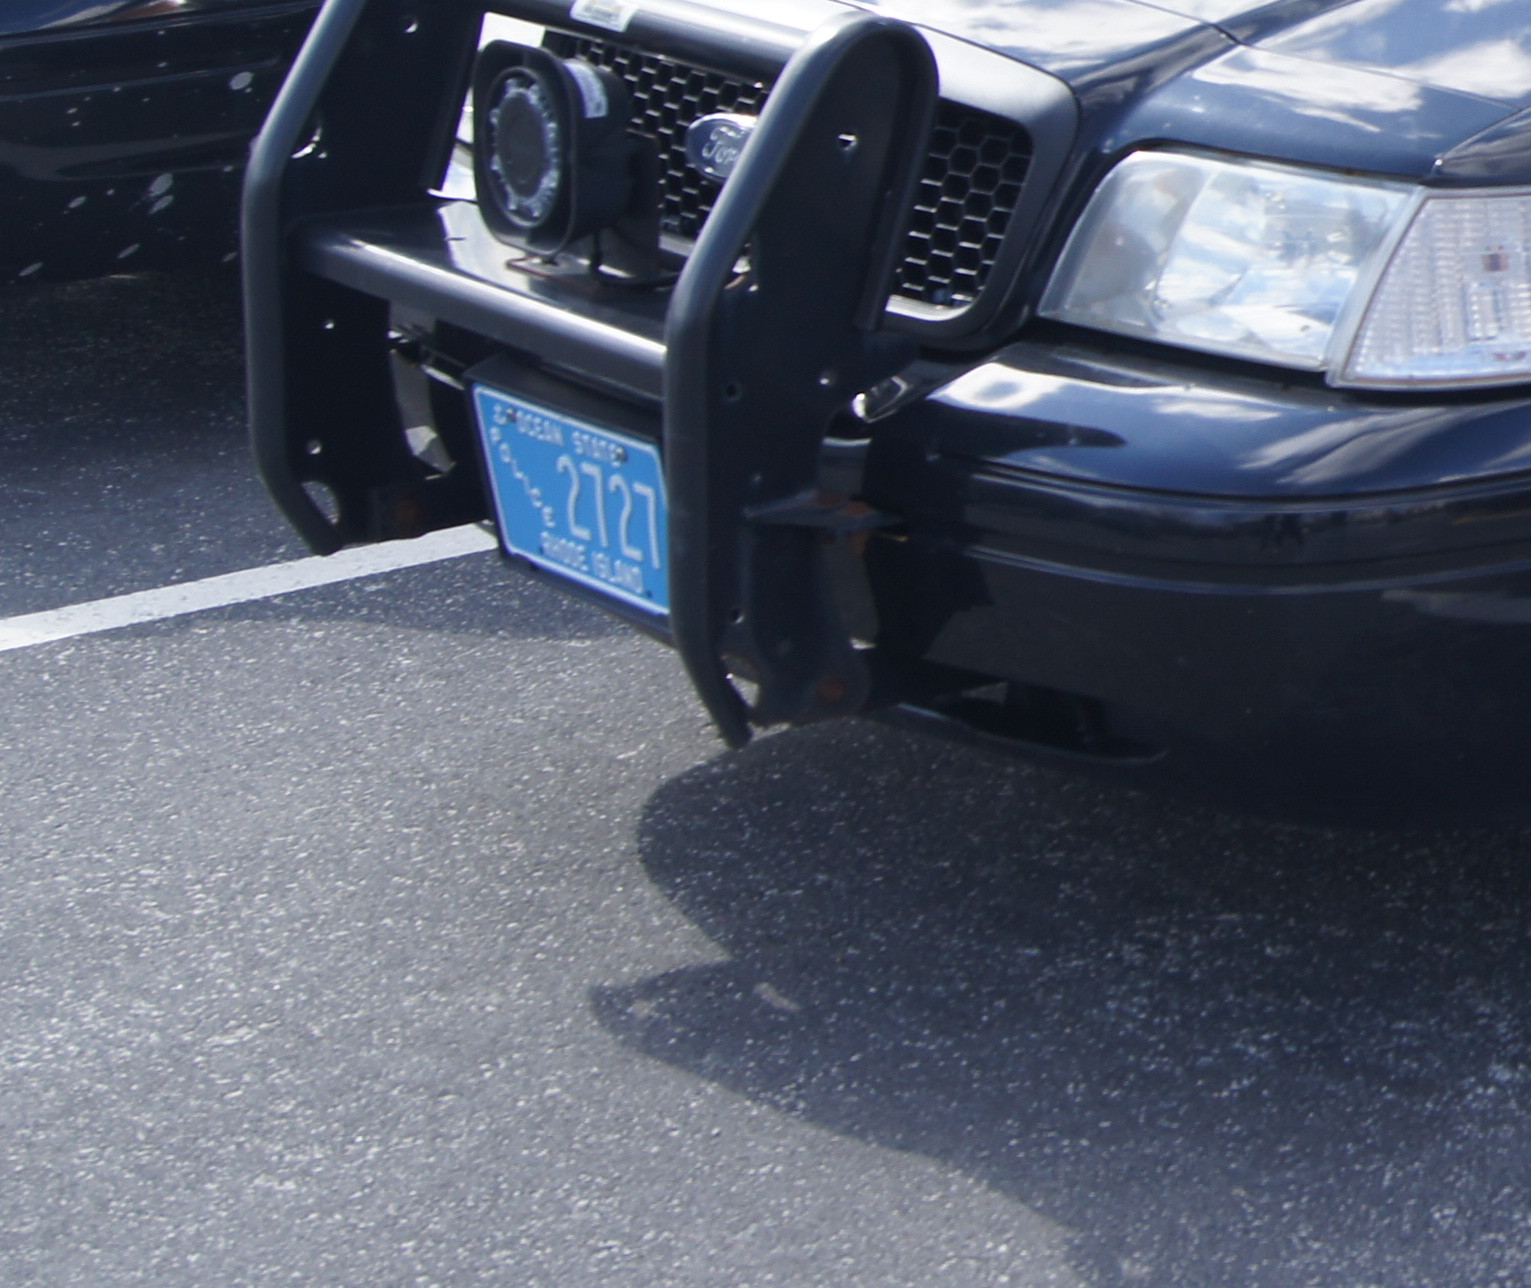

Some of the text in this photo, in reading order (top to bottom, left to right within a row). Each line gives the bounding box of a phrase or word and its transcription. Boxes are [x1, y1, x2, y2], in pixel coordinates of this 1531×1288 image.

[516, 410, 565, 446] OCEAN
[556, 453, 661, 570] 2727
[540, 531, 644, 594] RHODE ISLAND
